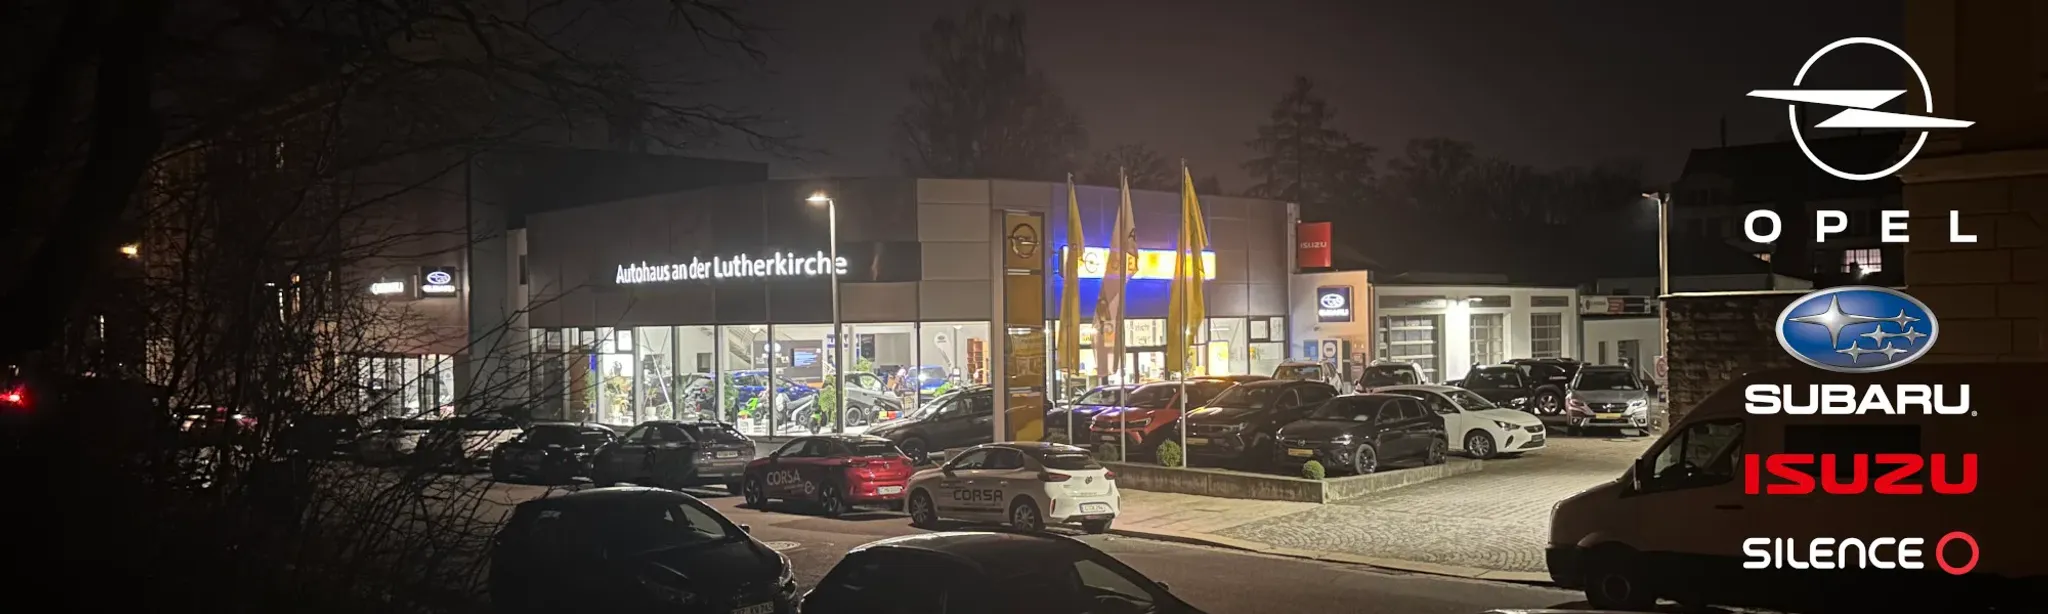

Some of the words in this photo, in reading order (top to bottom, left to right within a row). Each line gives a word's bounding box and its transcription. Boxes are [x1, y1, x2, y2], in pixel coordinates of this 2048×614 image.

[1300, 241, 1327, 249] ISUZU
[616, 261, 670, 284] Autohaus
[672, 264, 687, 281] an
[689, 256, 711, 279] der
[714, 251, 848, 278] Lutherkirche
[766, 468, 800, 486] CORSA
[953, 489, 1003, 502] CORSA
